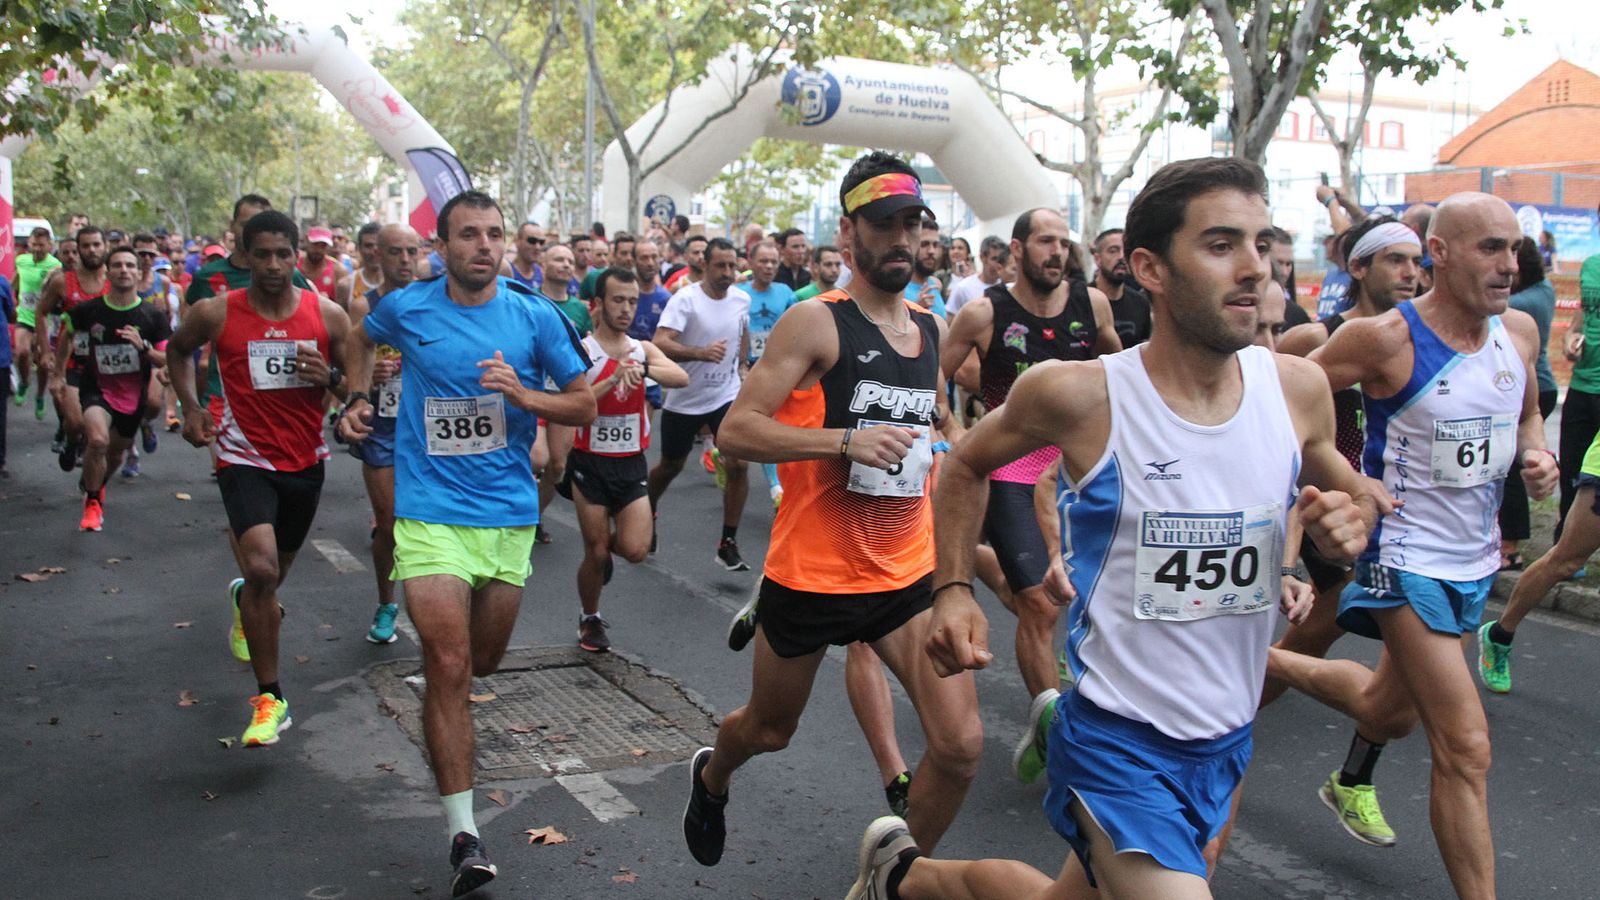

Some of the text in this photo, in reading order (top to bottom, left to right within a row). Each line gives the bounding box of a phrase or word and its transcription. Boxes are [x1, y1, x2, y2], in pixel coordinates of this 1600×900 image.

[845, 75, 949, 96] Ayuntamiento
[875, 92, 950, 110] de Huelva
[911, 112, 950, 123] Deportes
[102, 354, 131, 366] 454
[266, 357, 297, 375] 65
[849, 379, 937, 422] PUNT
[435, 416, 493, 440] 386
[597, 427, 633, 442] 596
[1457, 439, 1490, 468] 61
[1147, 518, 1180, 529] XXXII
[1184, 520, 1228, 531] VUELTA
[1146, 530, 1157, 542] A
[1163, 530, 1229, 544] HUELVA
[1154, 545, 1259, 592] 450
